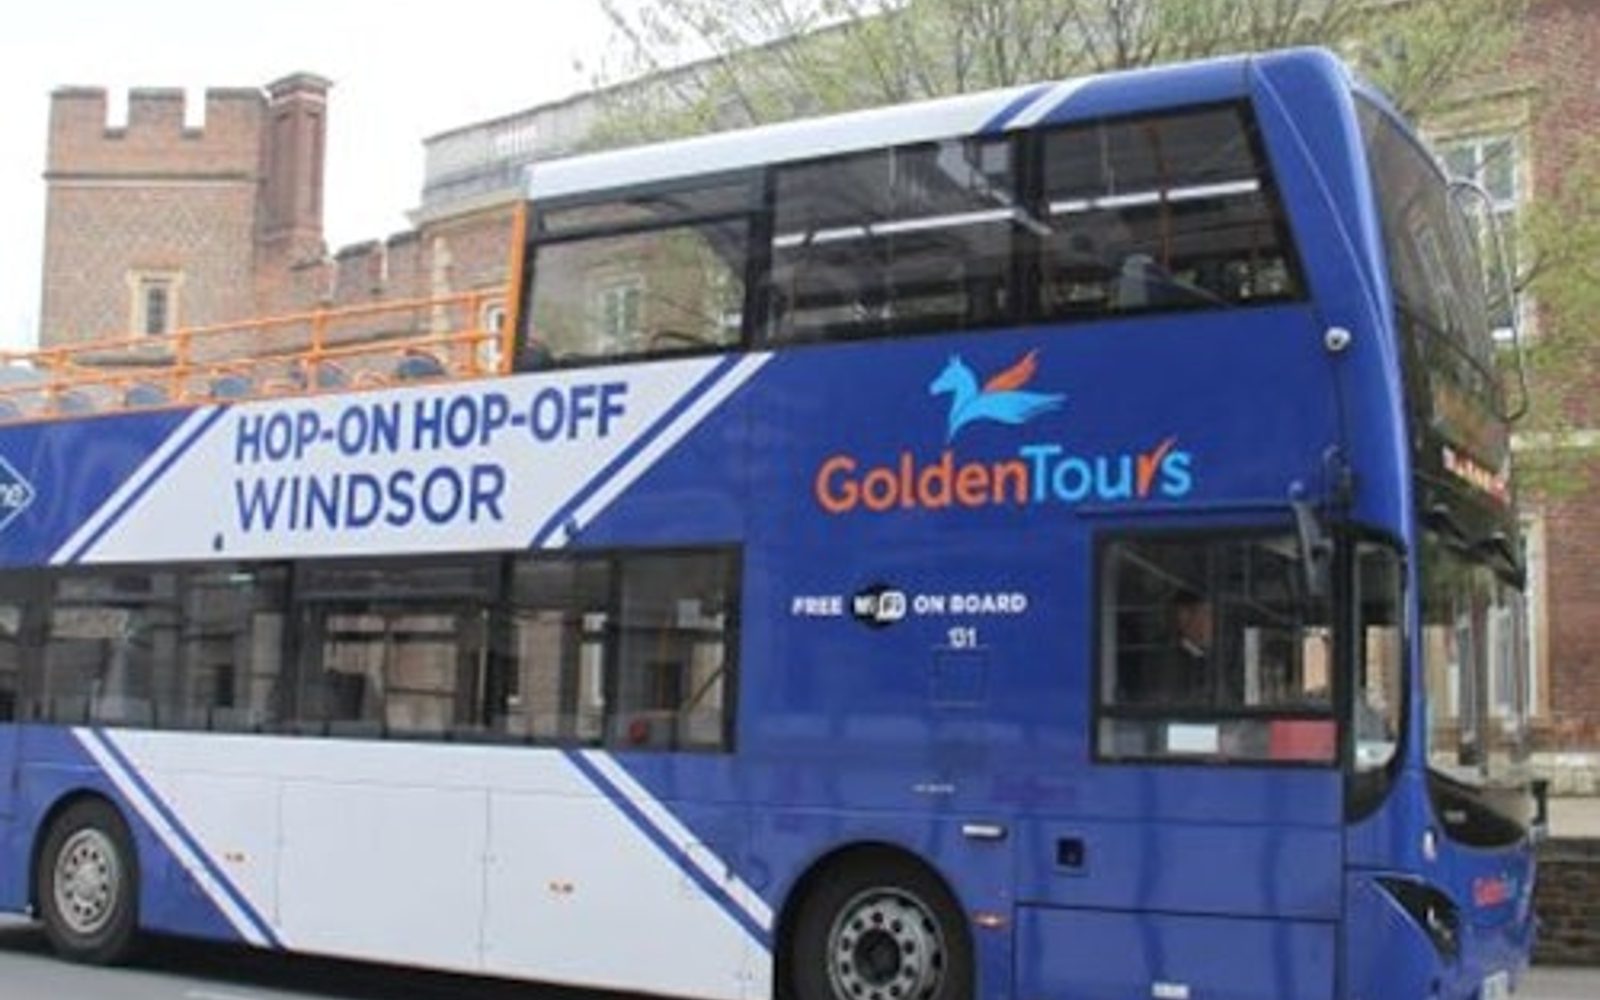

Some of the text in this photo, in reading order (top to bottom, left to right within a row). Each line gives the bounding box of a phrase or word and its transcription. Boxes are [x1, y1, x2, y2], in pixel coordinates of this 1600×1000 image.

[236, 382, 627, 464] HOP-ON HOP-OFF
[235, 464, 505, 533] WINDSOR
[792, 596, 843, 616] FREE
[913, 595, 945, 613] ON
[951, 593, 1027, 614] BOARD
